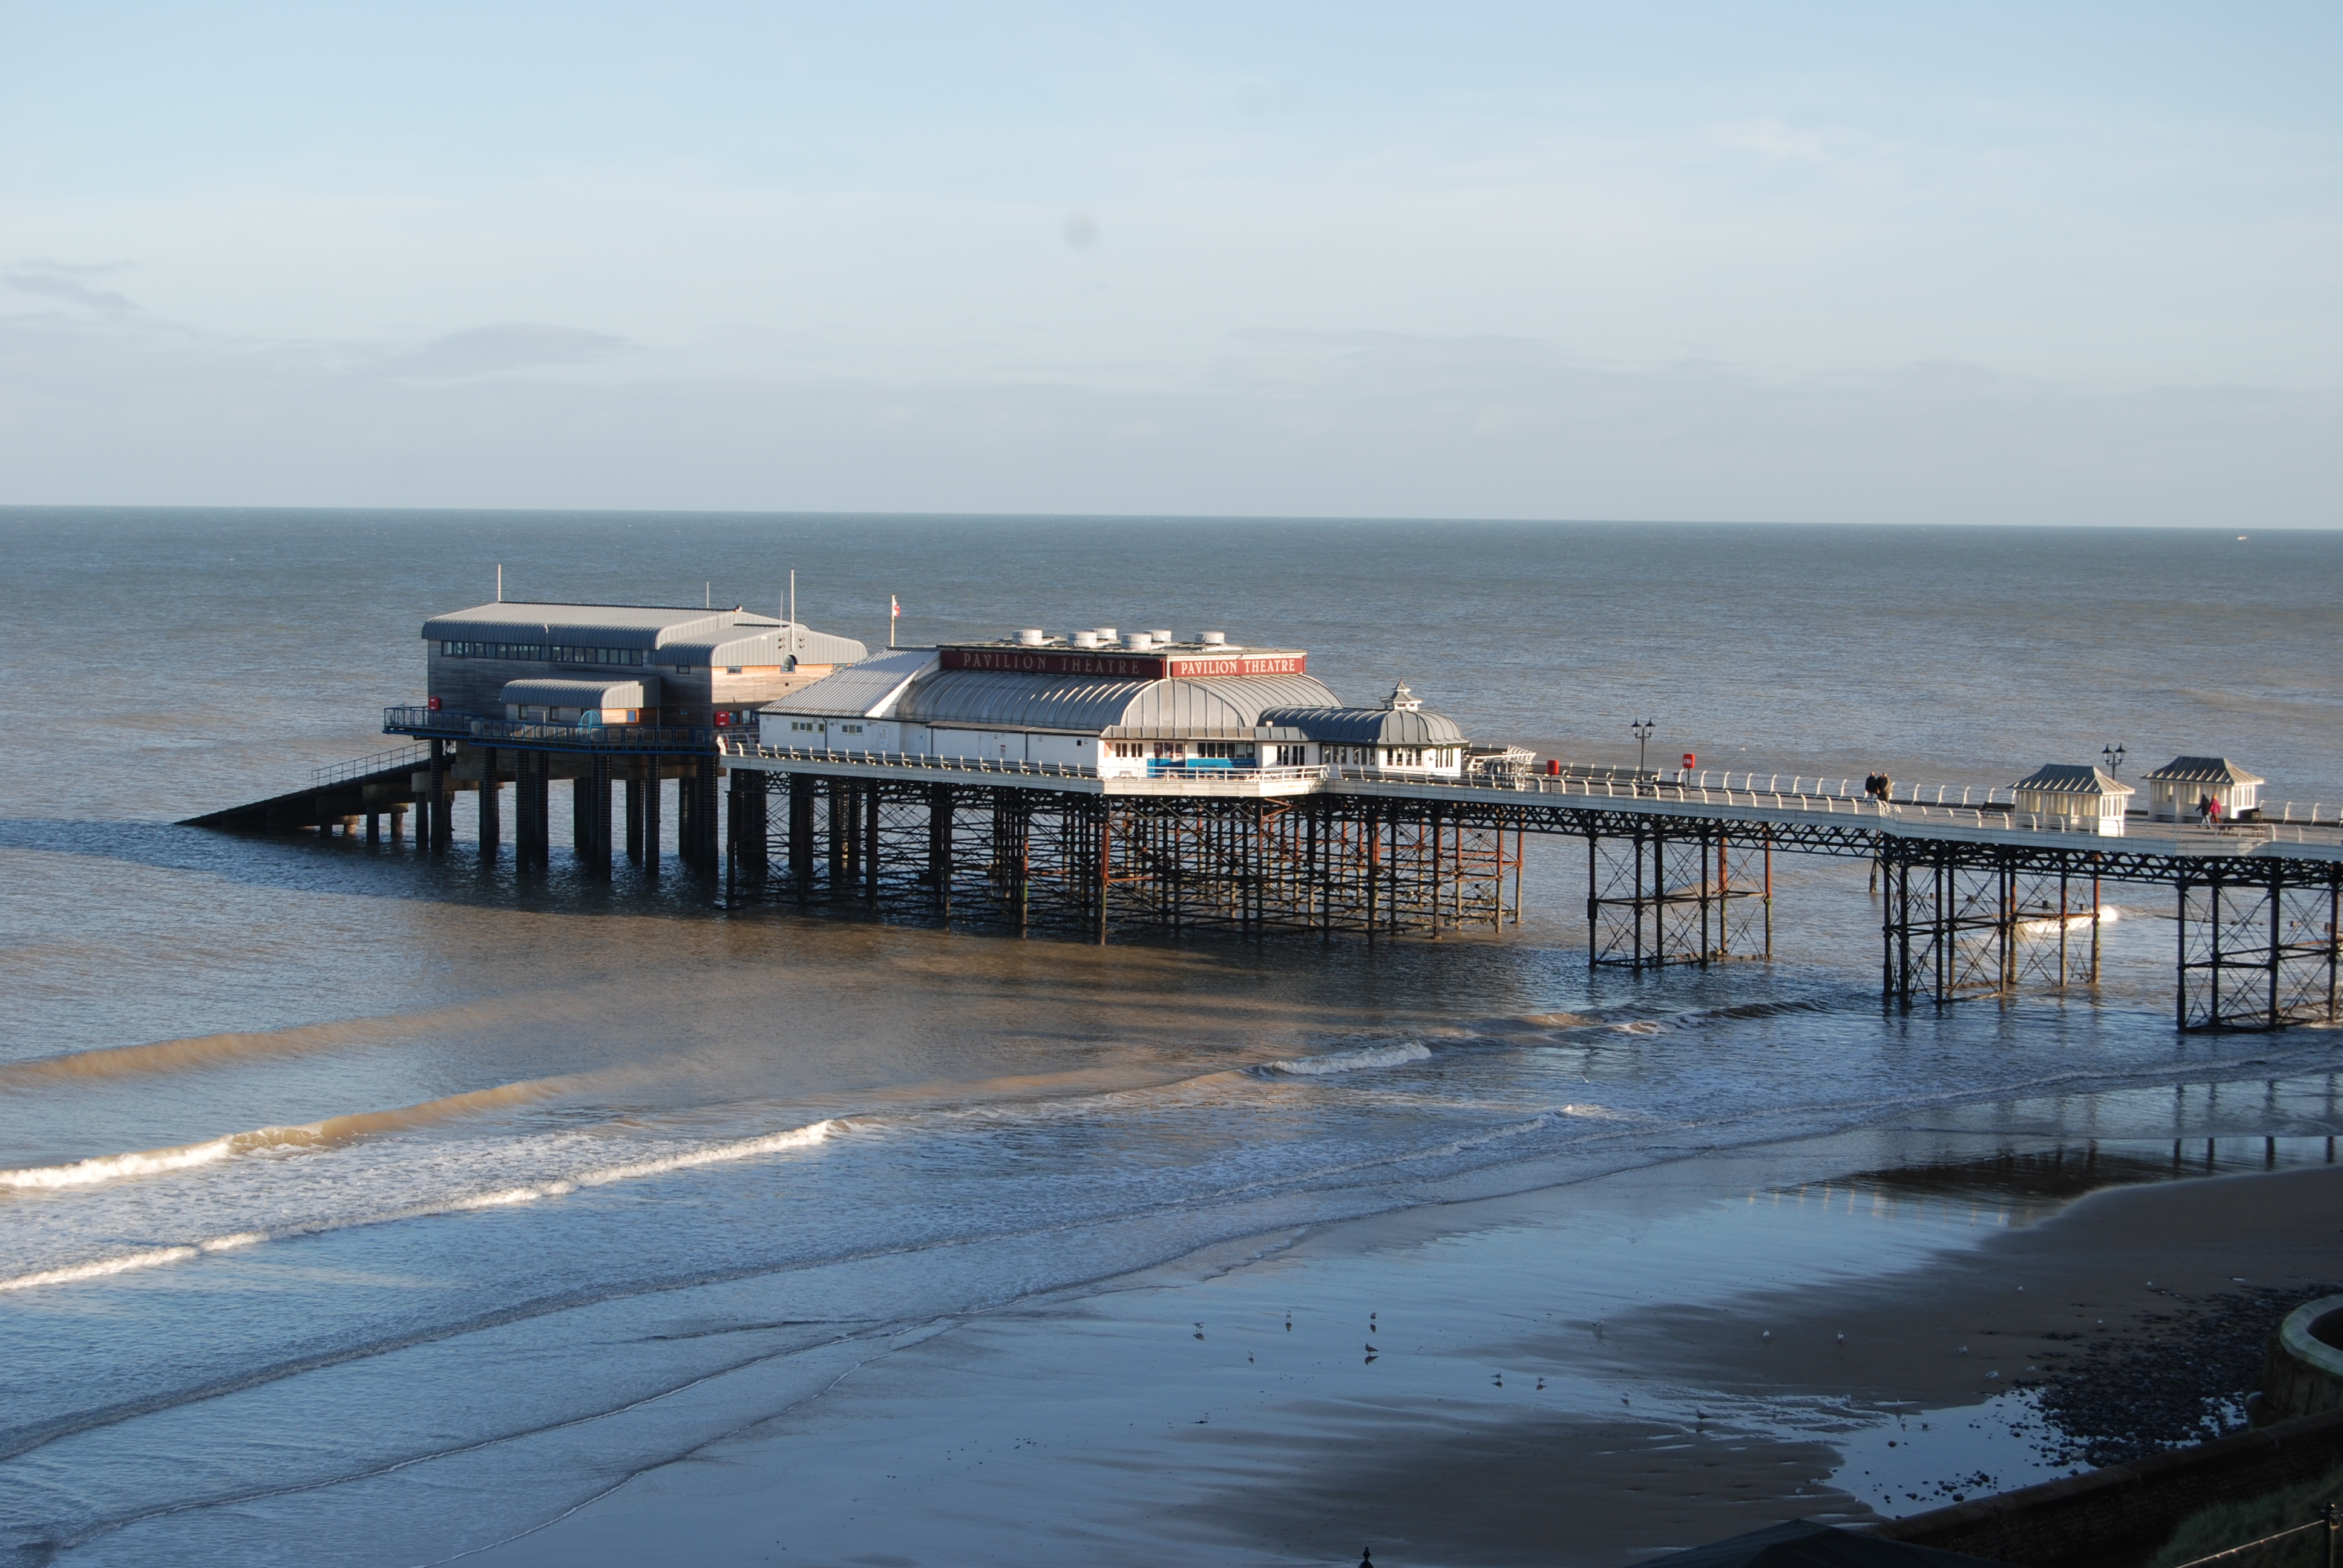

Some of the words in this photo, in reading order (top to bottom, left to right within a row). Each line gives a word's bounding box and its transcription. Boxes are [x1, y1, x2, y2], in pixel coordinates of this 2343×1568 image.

[963, 653, 1046, 670] PAVILION
[1061, 658, 1139, 674] THEATRE
[1181, 661, 1237, 674] PAVILION
[1244, 659, 1295, 671] THEATRE
